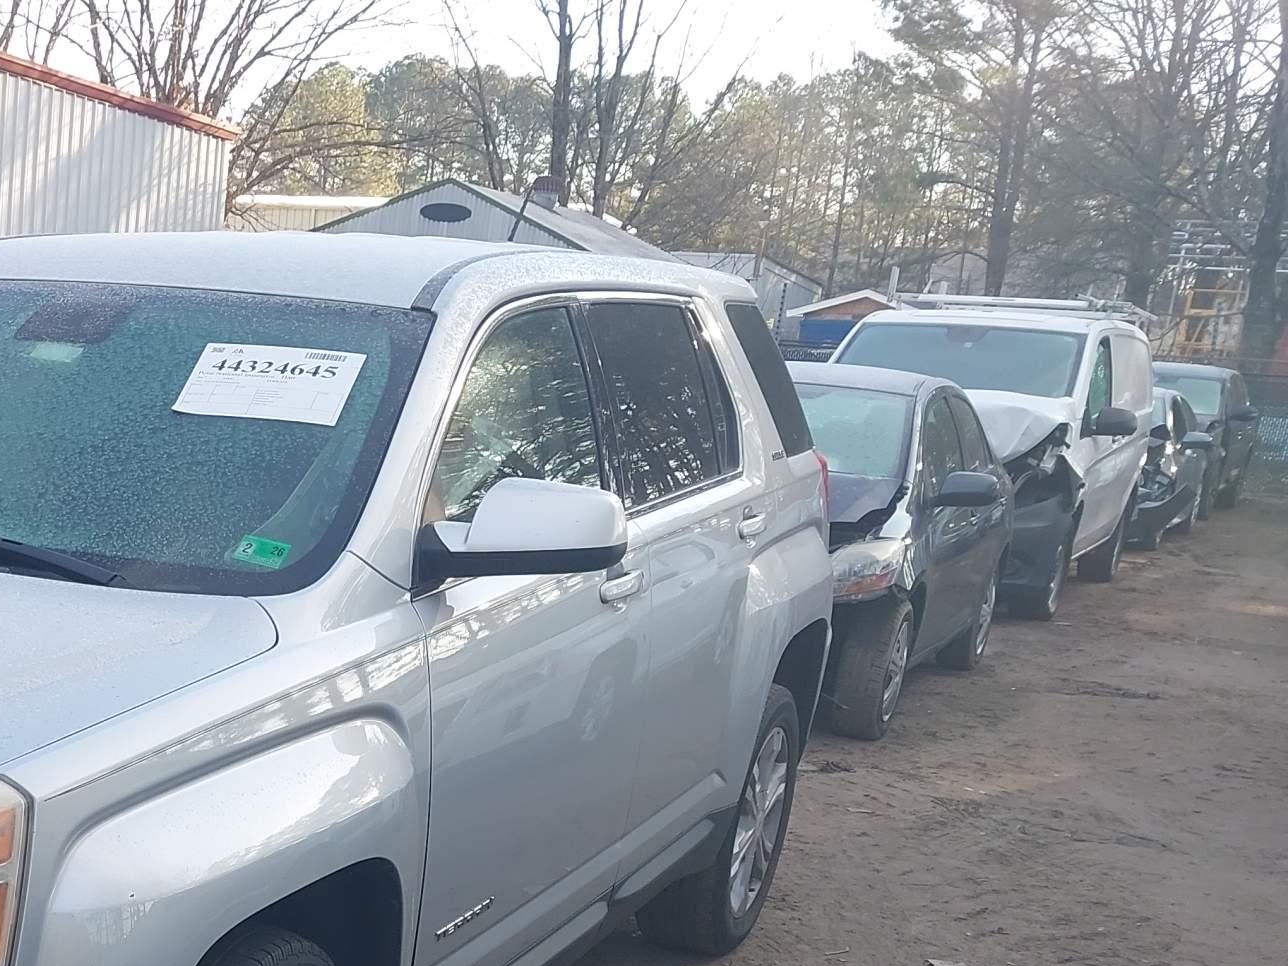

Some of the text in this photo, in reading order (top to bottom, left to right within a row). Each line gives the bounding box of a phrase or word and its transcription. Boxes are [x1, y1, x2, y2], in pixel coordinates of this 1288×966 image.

[211, 358, 340, 379] 44324645
[242, 542, 286, 557] 2 26
